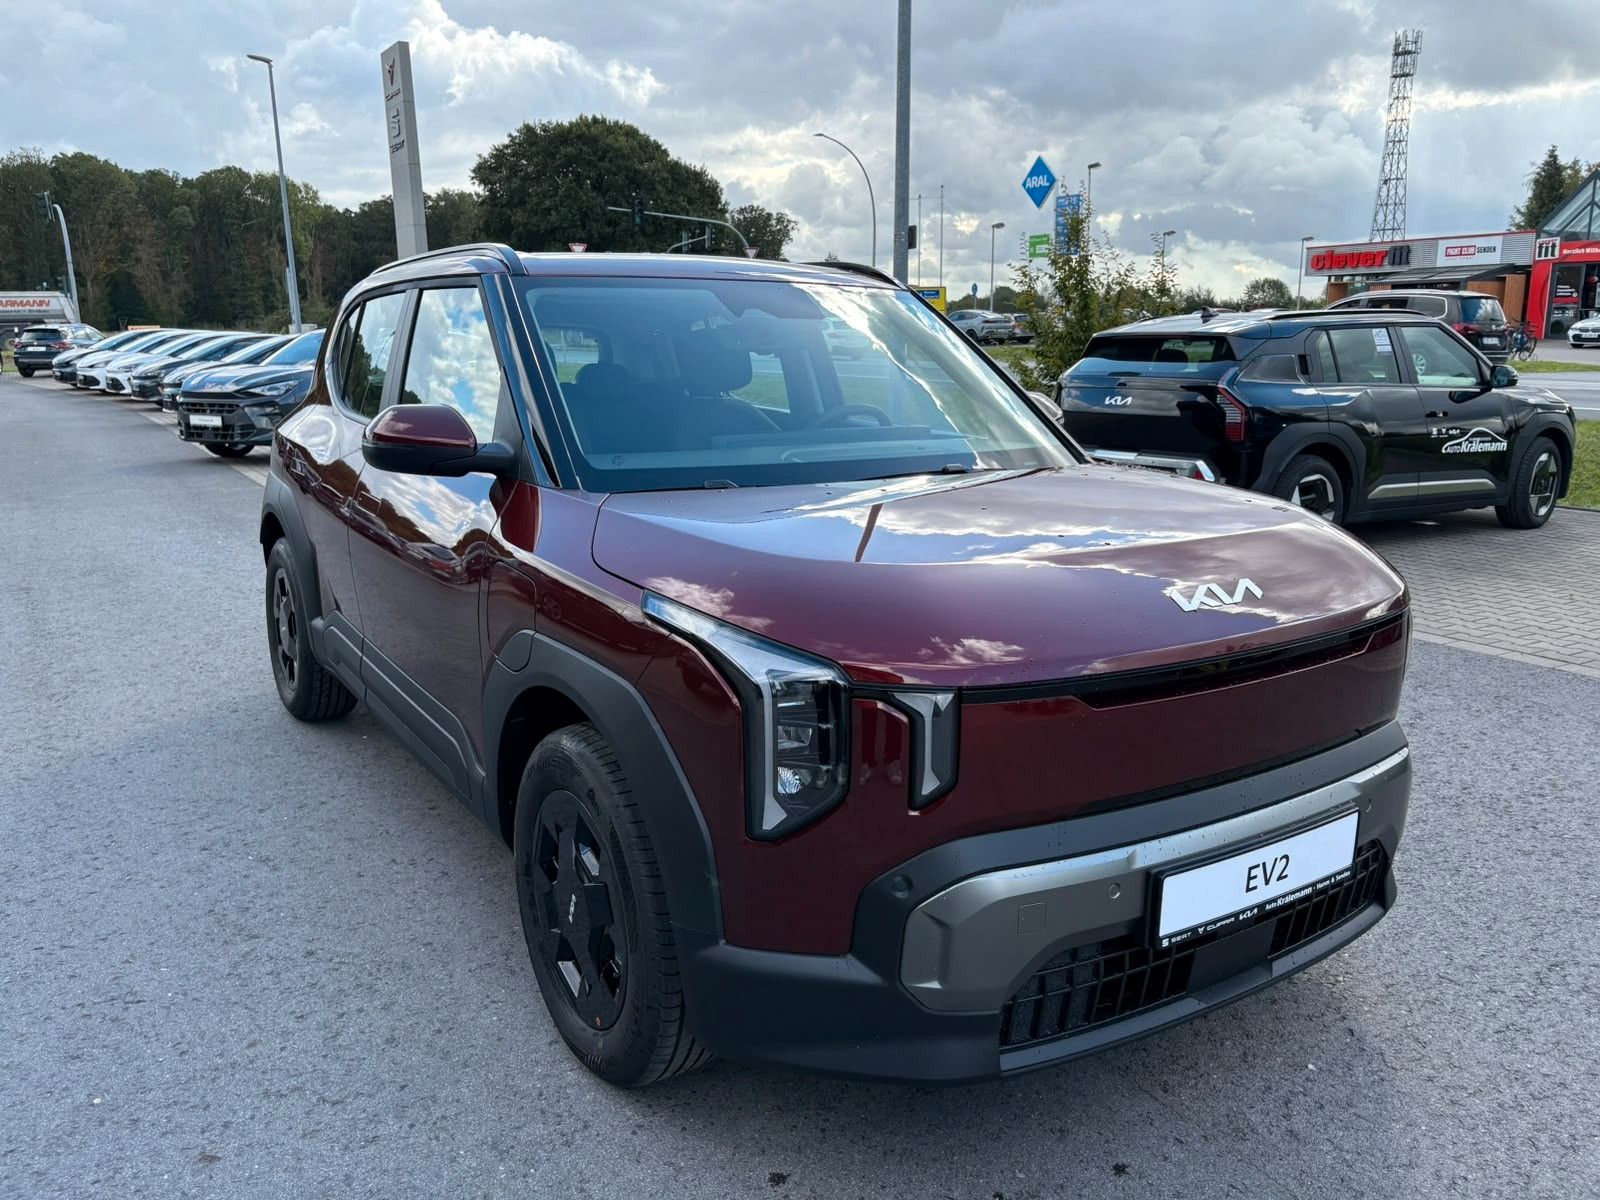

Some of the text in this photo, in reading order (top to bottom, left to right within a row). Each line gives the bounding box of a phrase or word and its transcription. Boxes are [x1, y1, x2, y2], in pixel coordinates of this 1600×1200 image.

[1025, 174, 1050, 189] ARAL
[1311, 245, 1411, 271] clever fit
[1105, 396, 1132, 405] KIA
[1171, 578, 1263, 612] KIA
[1245, 854, 1290, 893] EV2
[1171, 932, 1192, 943] SEAT
[1206, 917, 1235, 931] CUPRA
[1239, 908, 1258, 920] KIA
[1265, 902, 1277, 910] Auto
